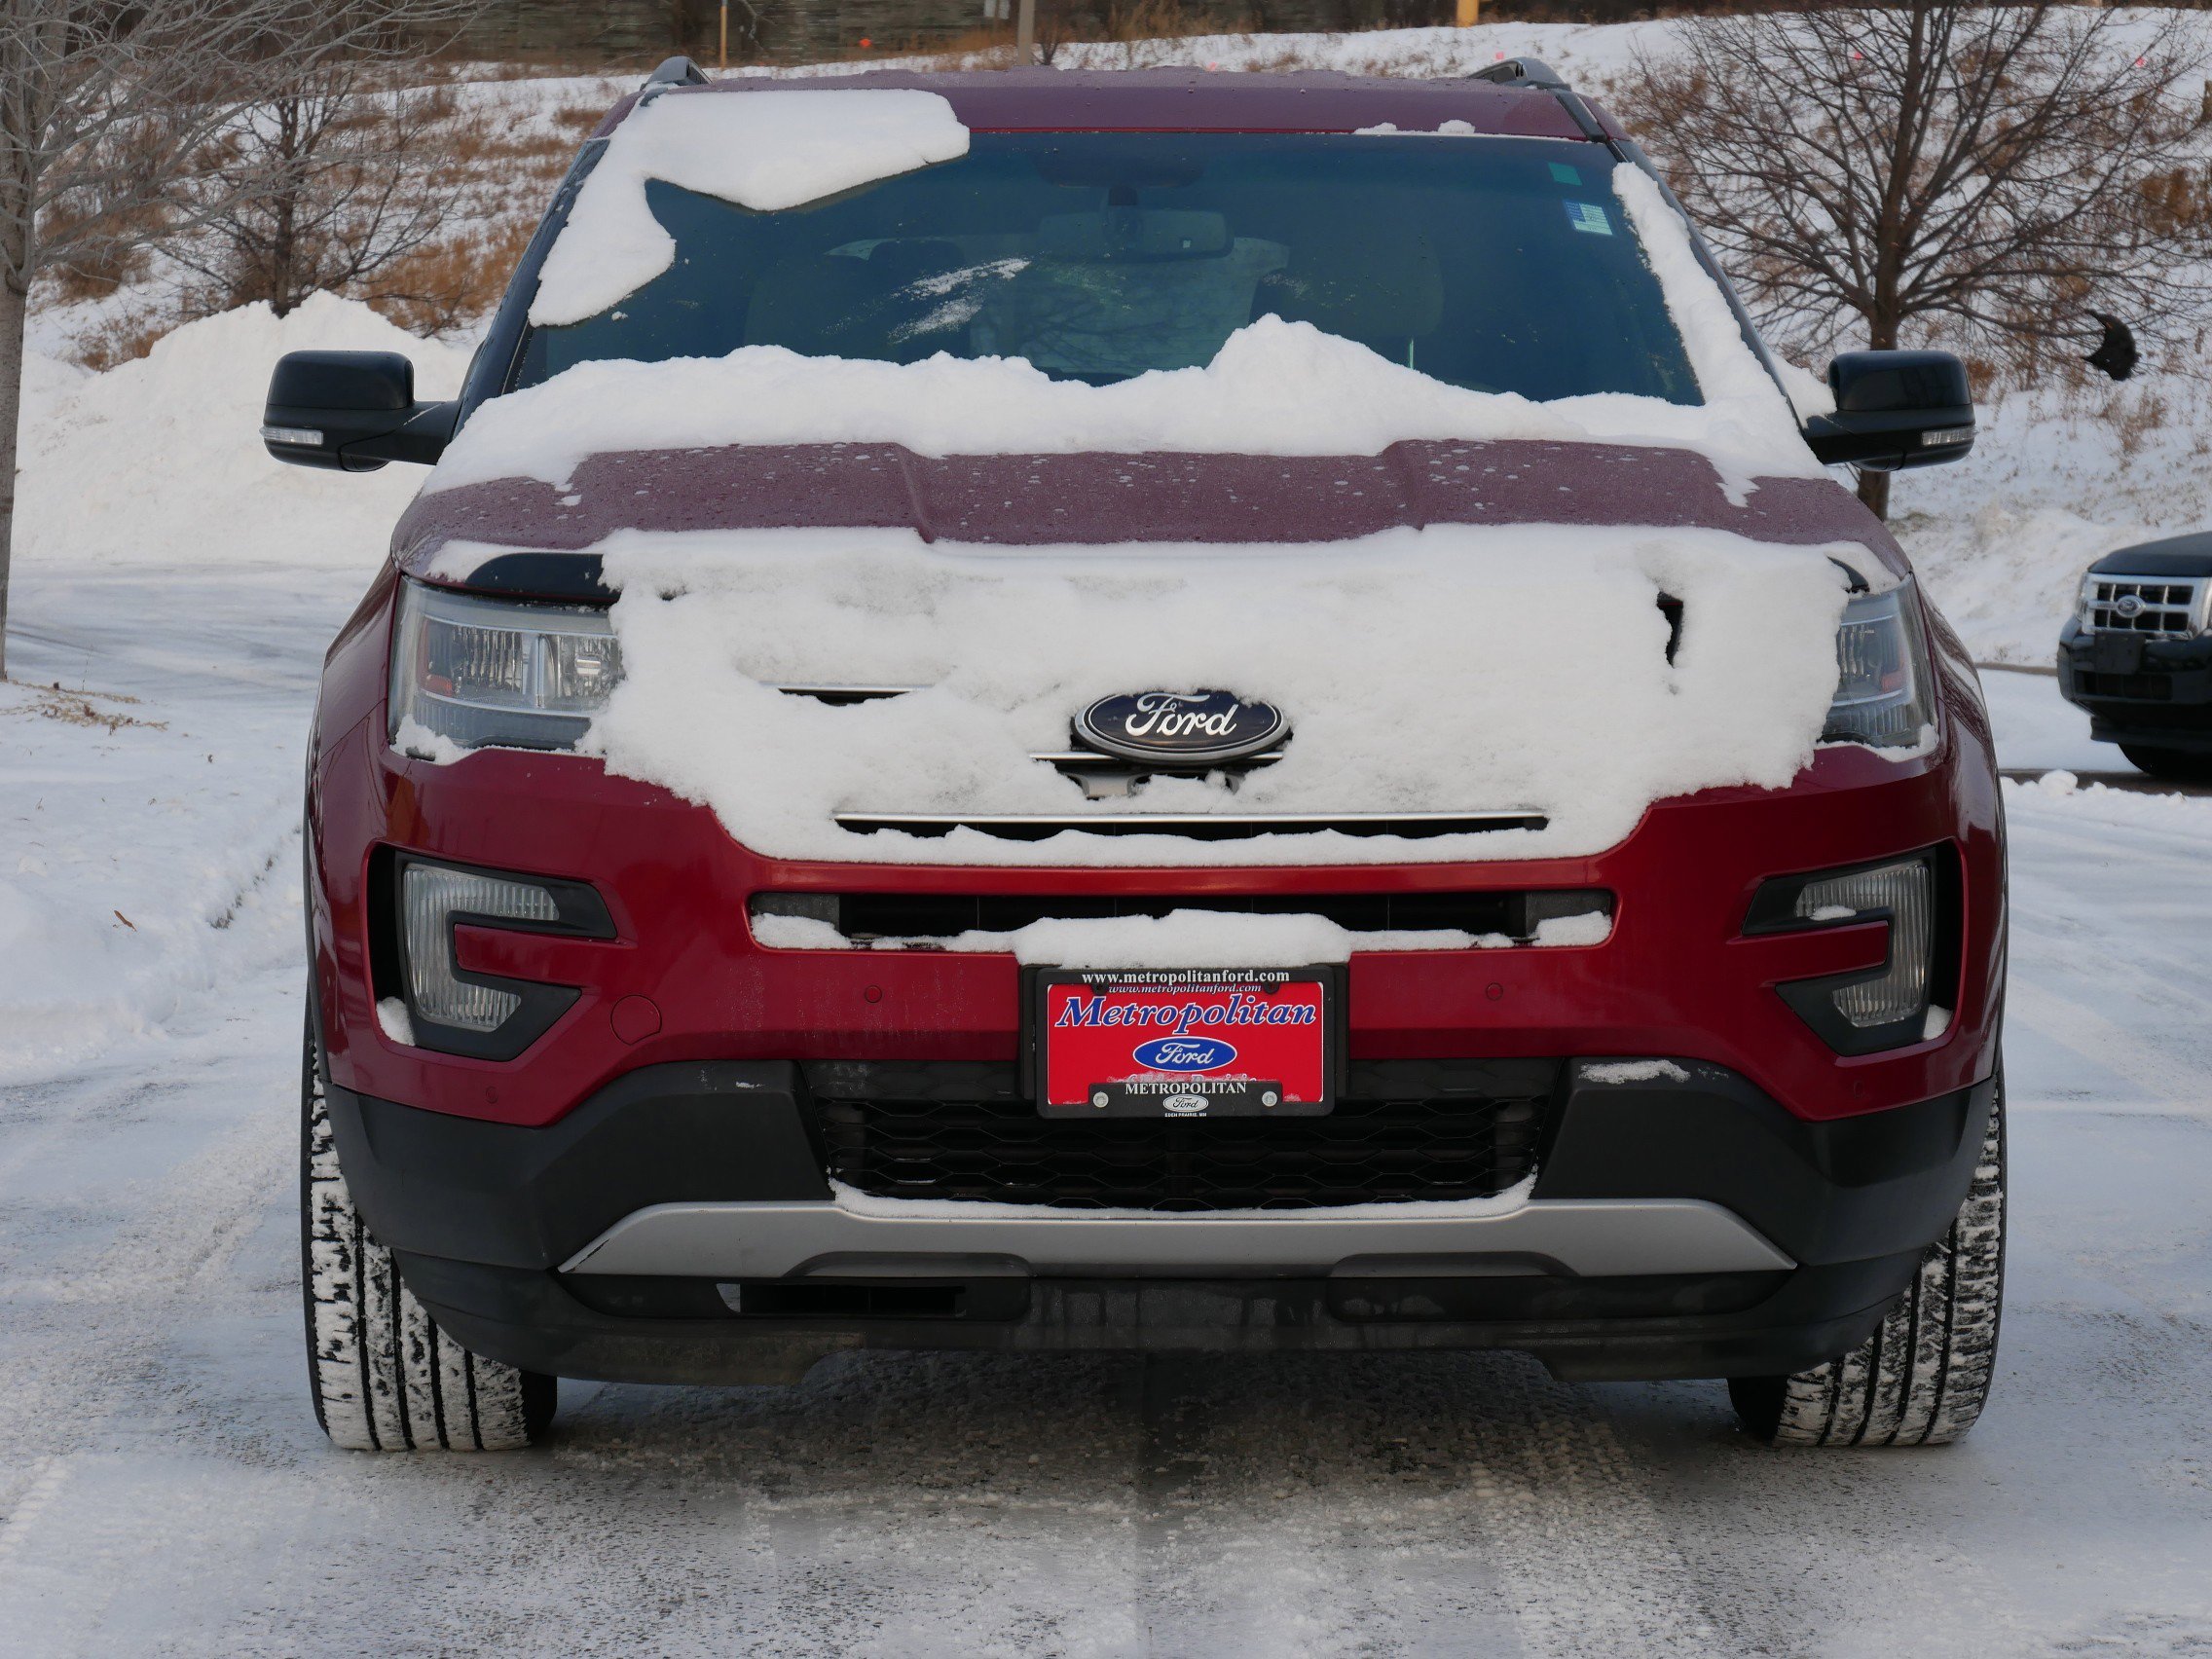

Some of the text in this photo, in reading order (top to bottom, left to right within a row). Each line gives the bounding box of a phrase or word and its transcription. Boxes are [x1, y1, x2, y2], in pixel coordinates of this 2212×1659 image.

[1124, 692, 1239, 736] Ford
[1082, 970, 1290, 986] www.metropolitanford.com
[1109, 983, 1263, 995] www.metropolitanford.com
[1054, 993, 1317, 1035] Metropolitan
[1155, 1042, 1214, 1065] Ford
[1125, 1082, 1247, 1095] METROPOLITAN
[1172, 1097, 1198, 1108] Ford
